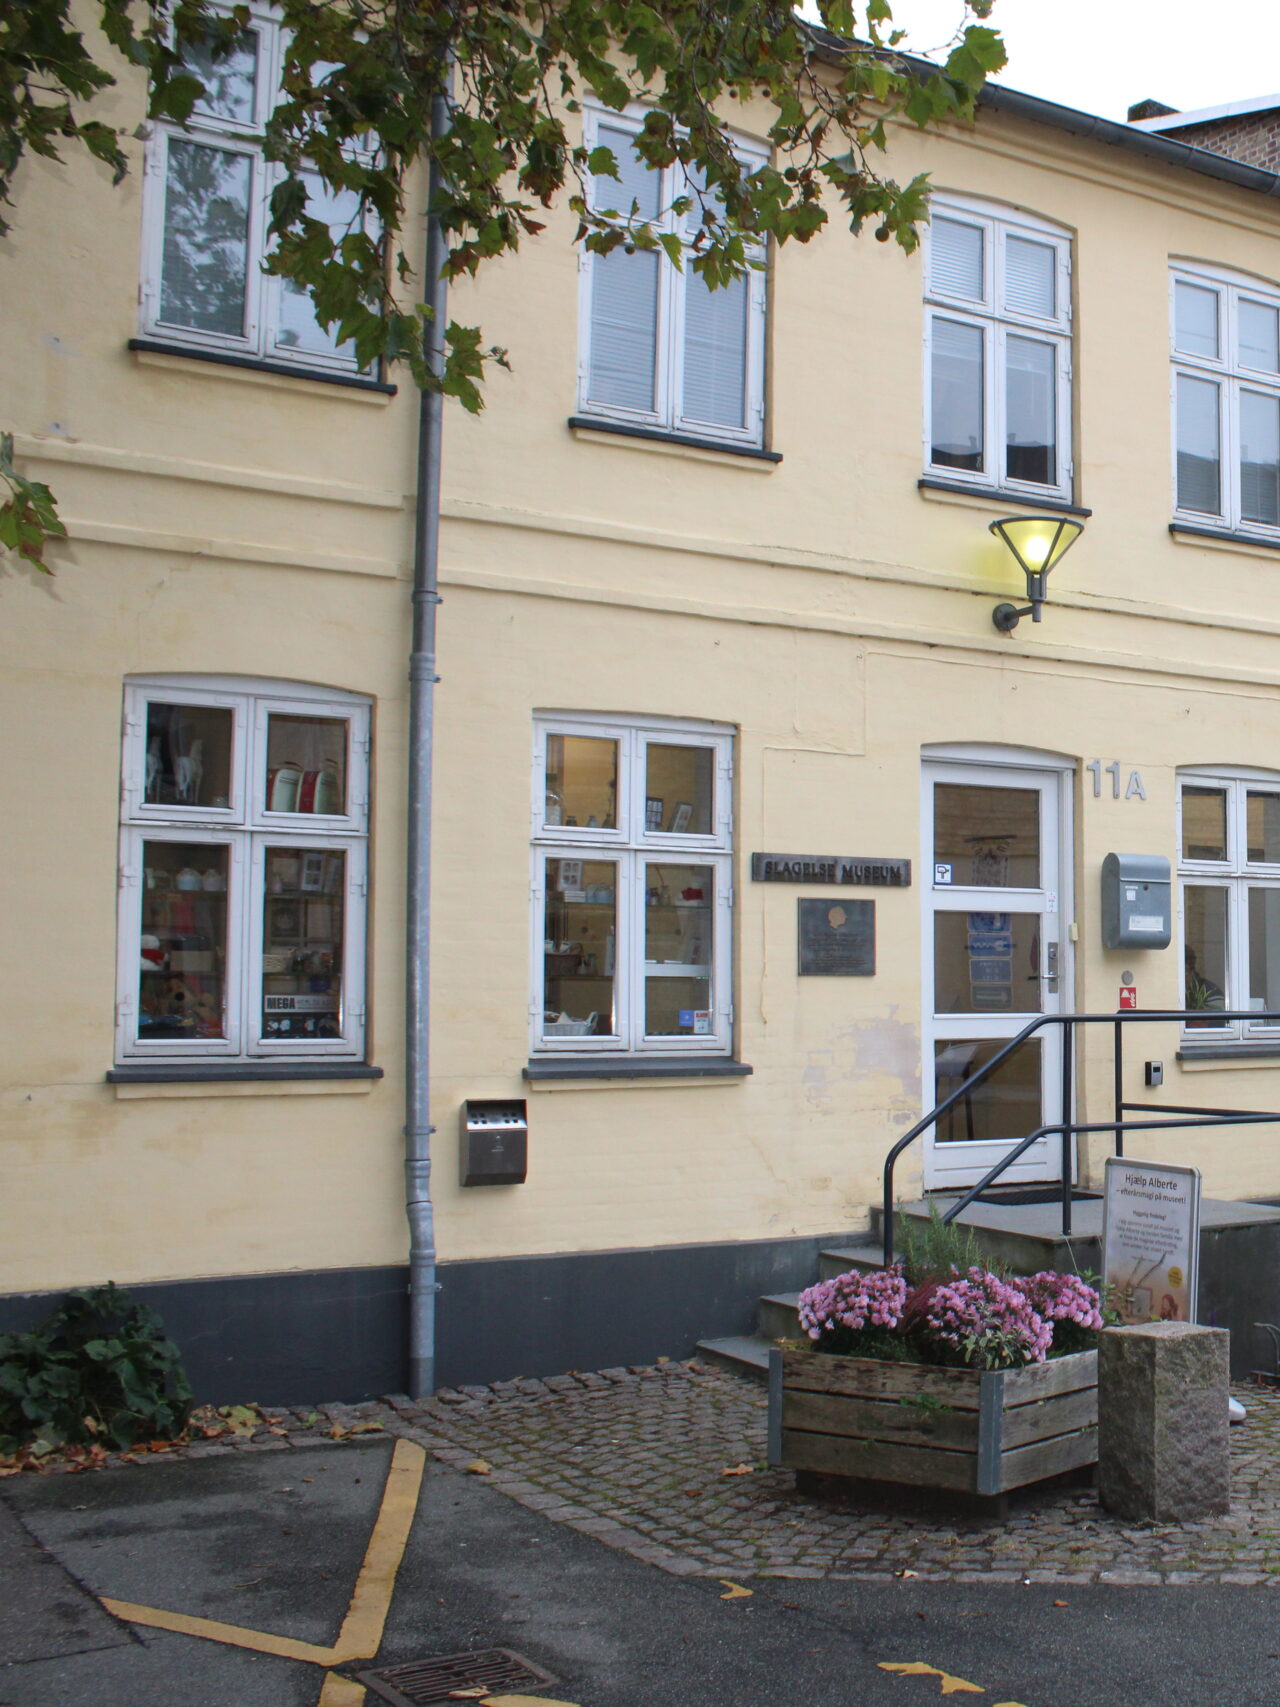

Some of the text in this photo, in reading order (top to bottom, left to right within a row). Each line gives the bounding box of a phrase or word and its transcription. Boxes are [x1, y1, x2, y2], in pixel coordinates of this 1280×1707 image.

[1087, 759, 1146, 800] 11A
[765, 860, 902, 880] SLAGELSE MUSEUM
[266, 997, 296, 1010] MEGA
[1125, 1173, 1178, 1191] Hjælp Alberte
